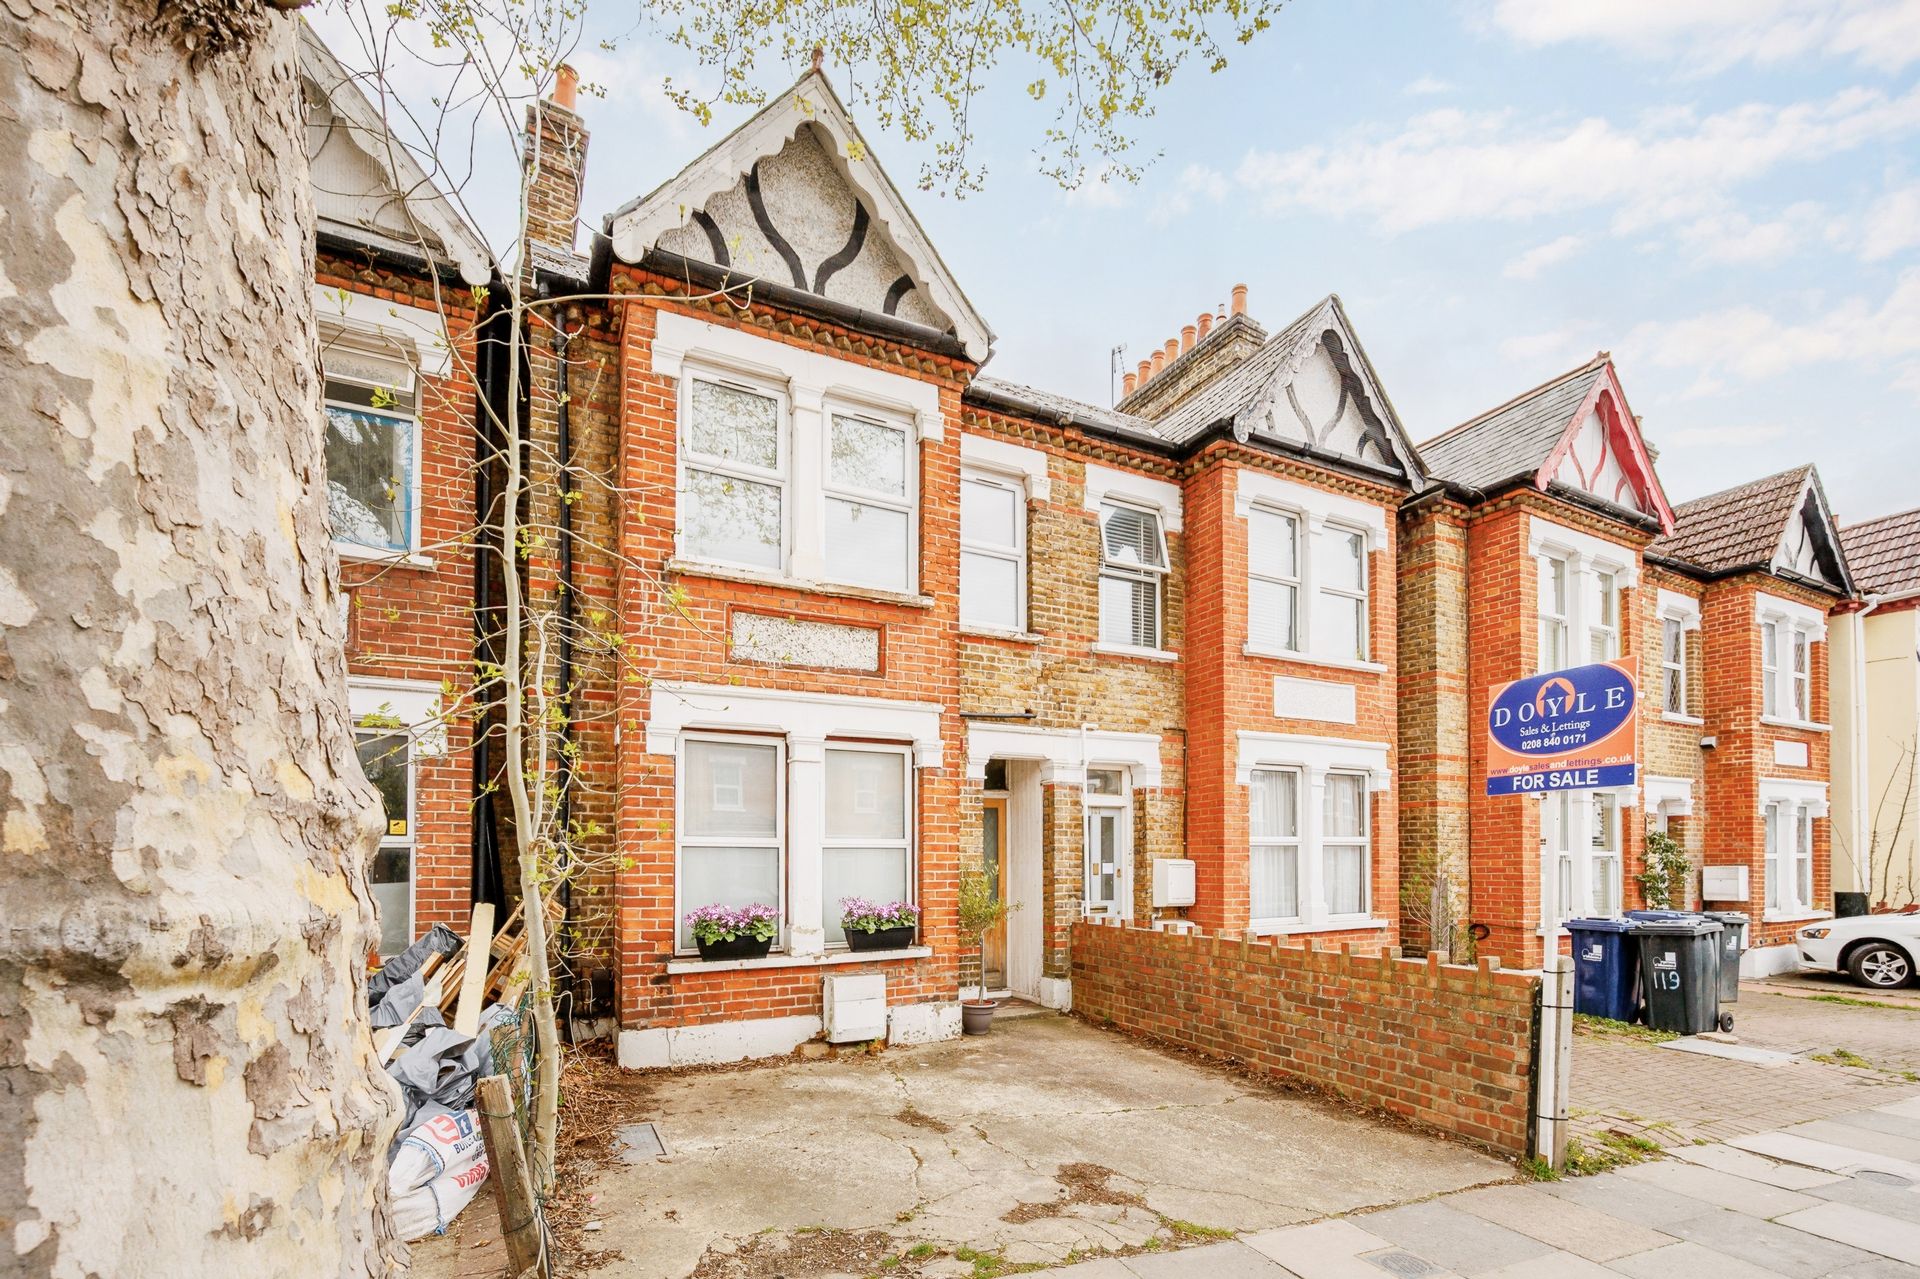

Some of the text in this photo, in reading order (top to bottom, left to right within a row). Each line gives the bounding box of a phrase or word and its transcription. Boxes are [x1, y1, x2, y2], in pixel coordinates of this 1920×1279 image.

[1494, 687, 1625, 727] DOYLE
[1520, 720, 1591, 737] Sales & Lettings
[1522, 733, 1586, 750] 0208 840 0171
[1490, 753, 1632, 775] www.doylesalesandlettings.co.uk
[1513, 769, 1599, 791] FOR SALE
